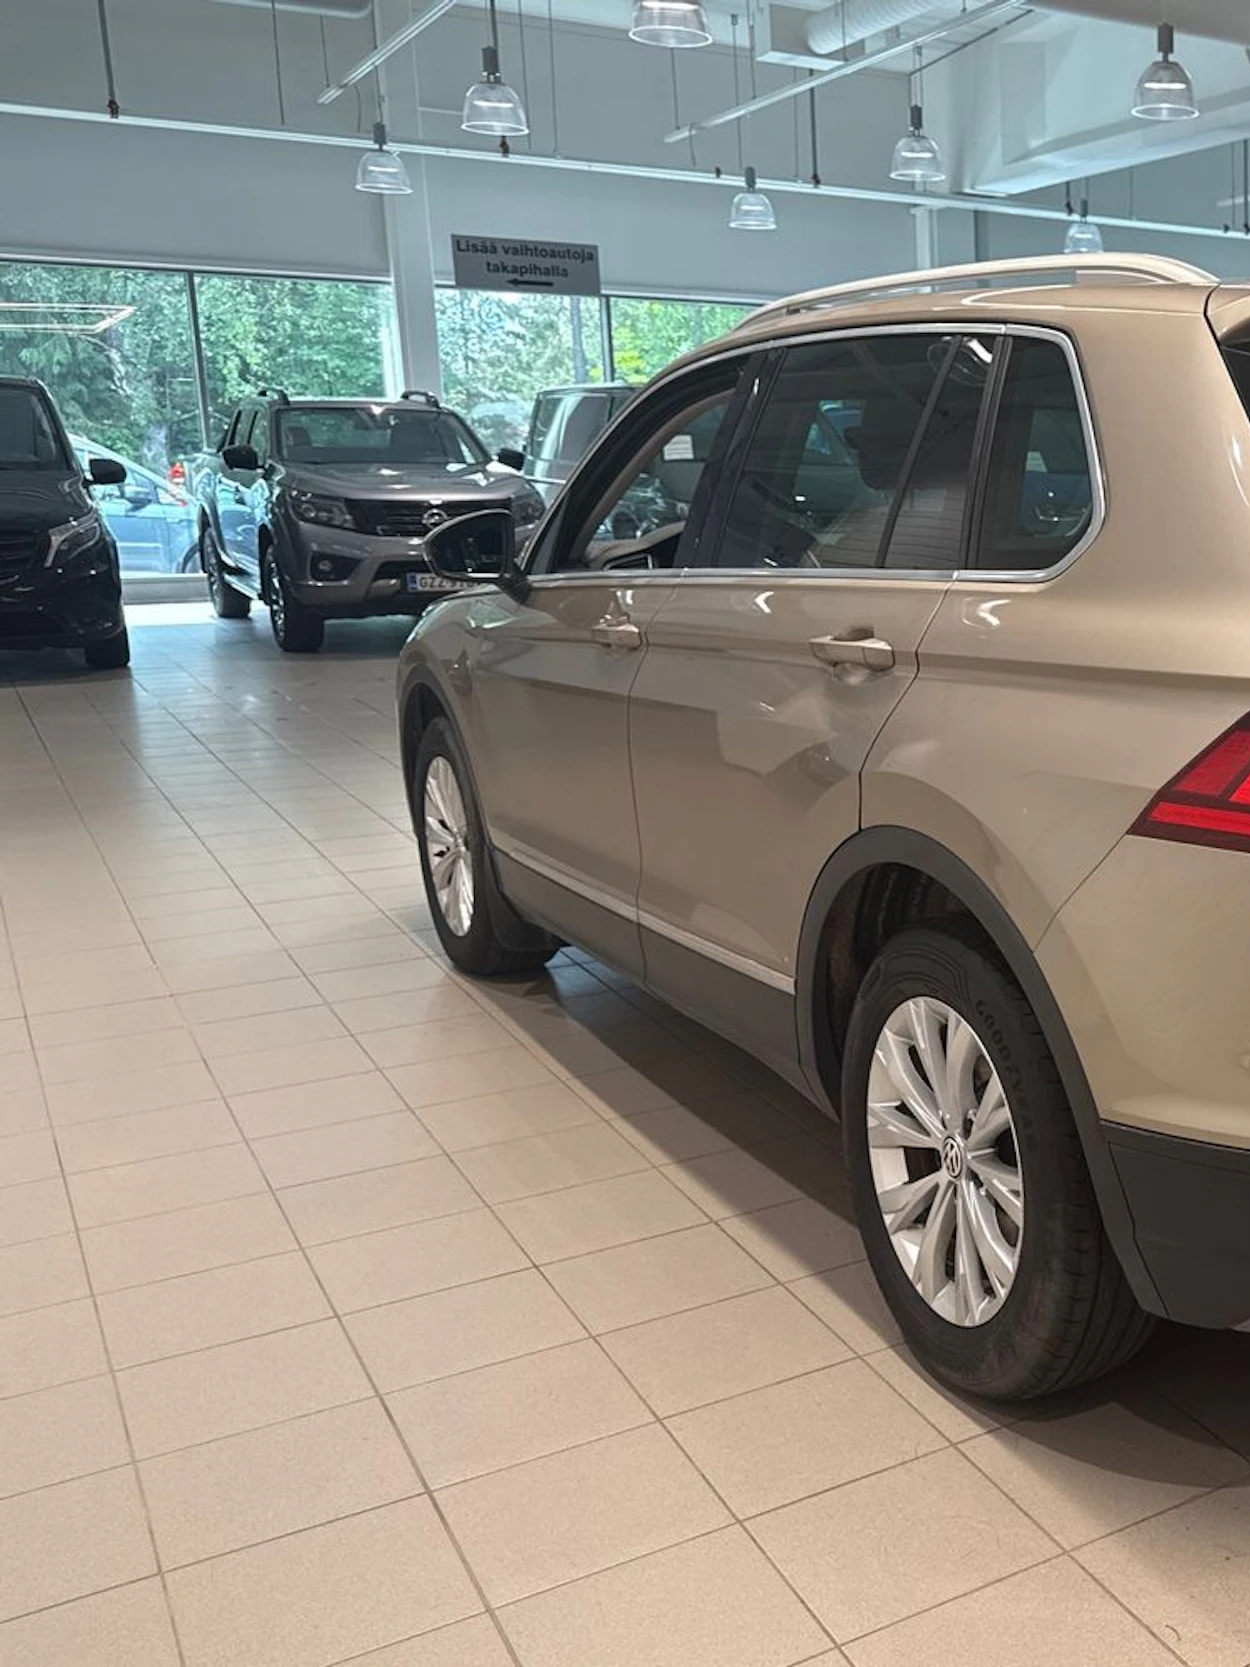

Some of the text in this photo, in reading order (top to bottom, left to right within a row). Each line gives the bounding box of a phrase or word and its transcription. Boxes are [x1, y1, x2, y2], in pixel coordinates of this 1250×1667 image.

[456, 239, 595, 263] Lisää vaihtoautoja
[486, 261, 569, 277] takapihalla
